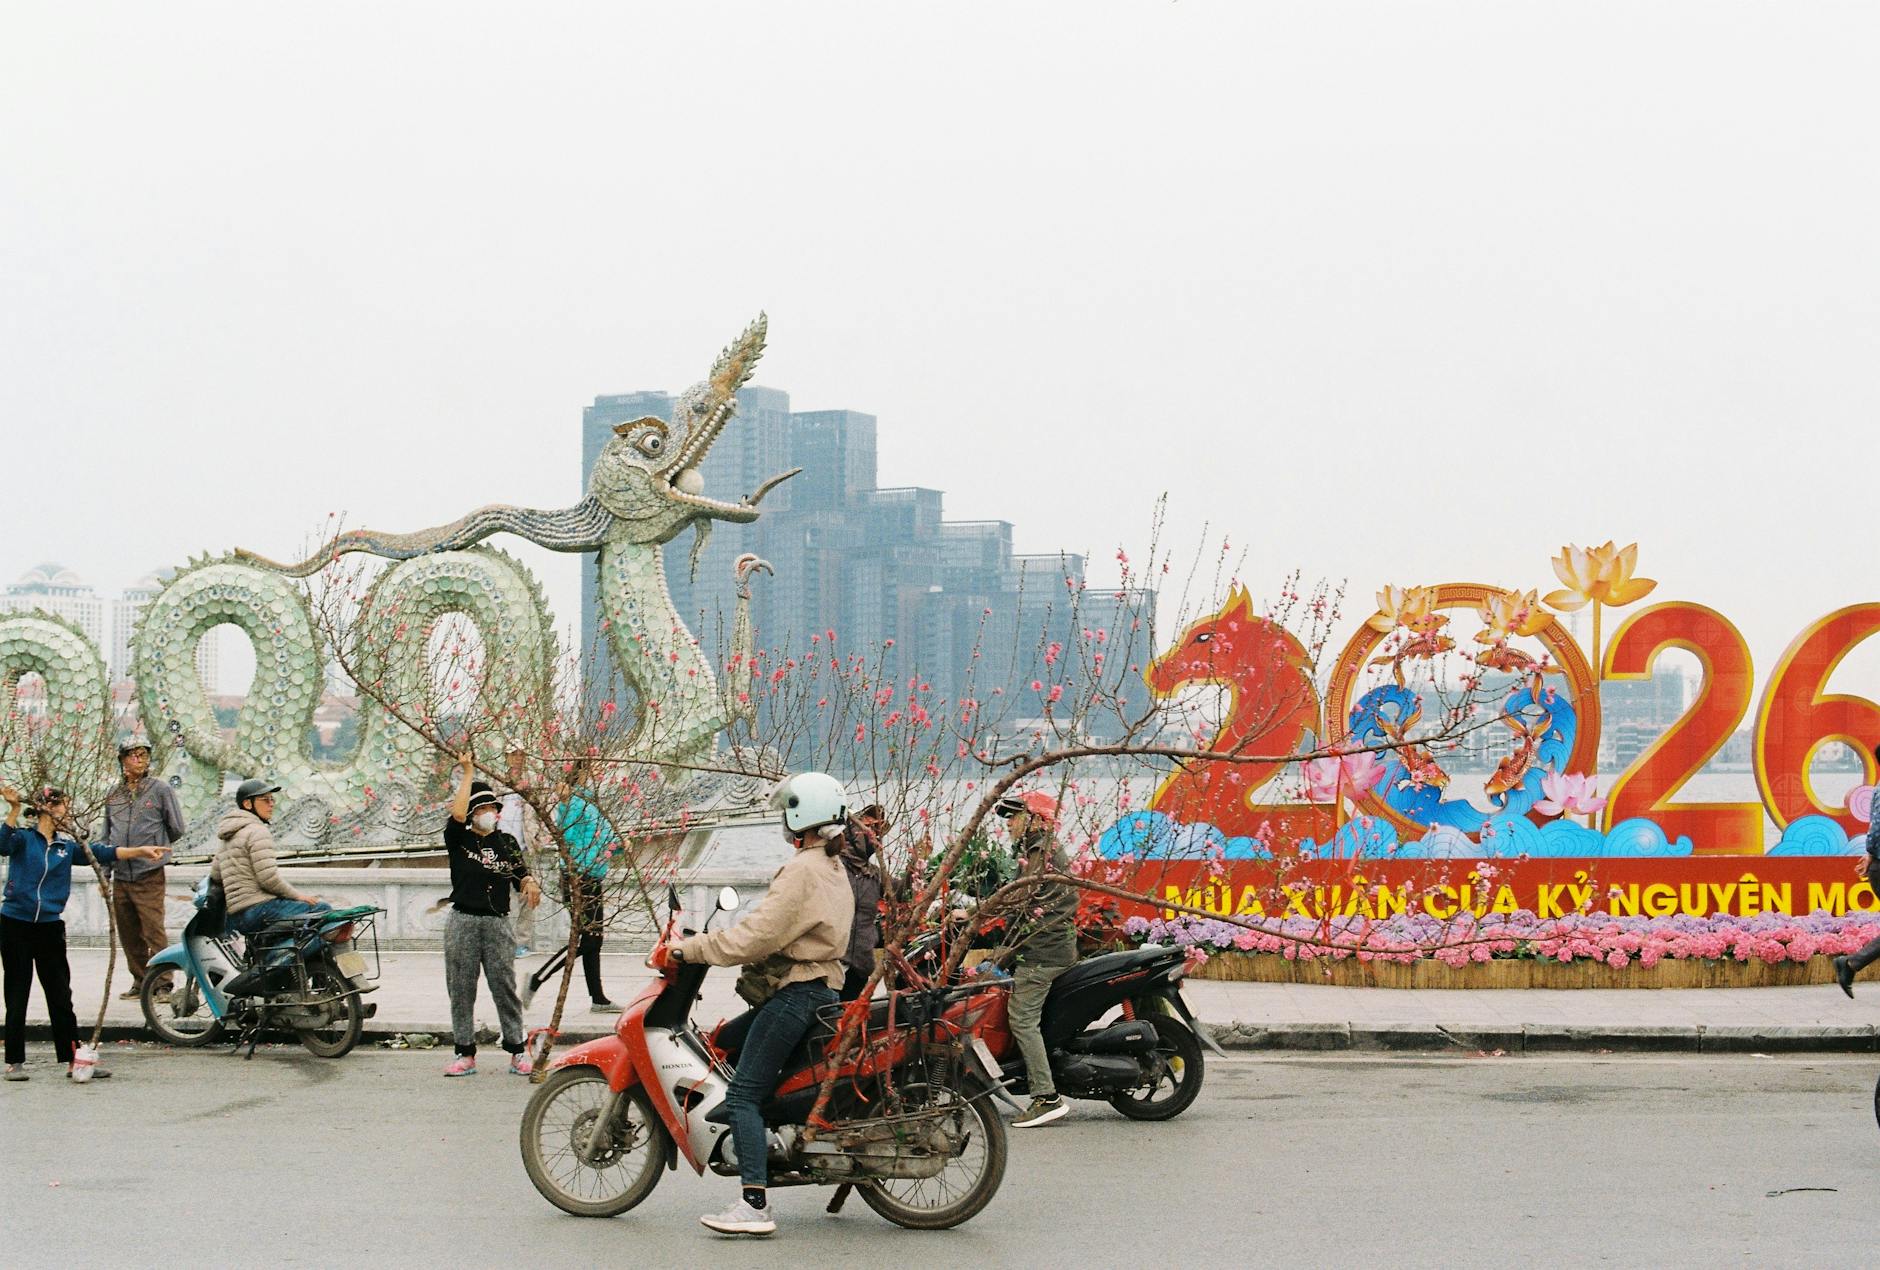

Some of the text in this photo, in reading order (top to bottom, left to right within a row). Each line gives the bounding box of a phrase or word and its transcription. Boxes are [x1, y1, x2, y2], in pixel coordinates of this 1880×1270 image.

[1165, 875, 1266, 920] MÙA
[1281, 875, 1407, 920] XUÂN
[1423, 871, 1519, 920] CỦA
[1538, 870, 1593, 919] KỶ
[1610, 872, 1792, 918] NGUYÊN
